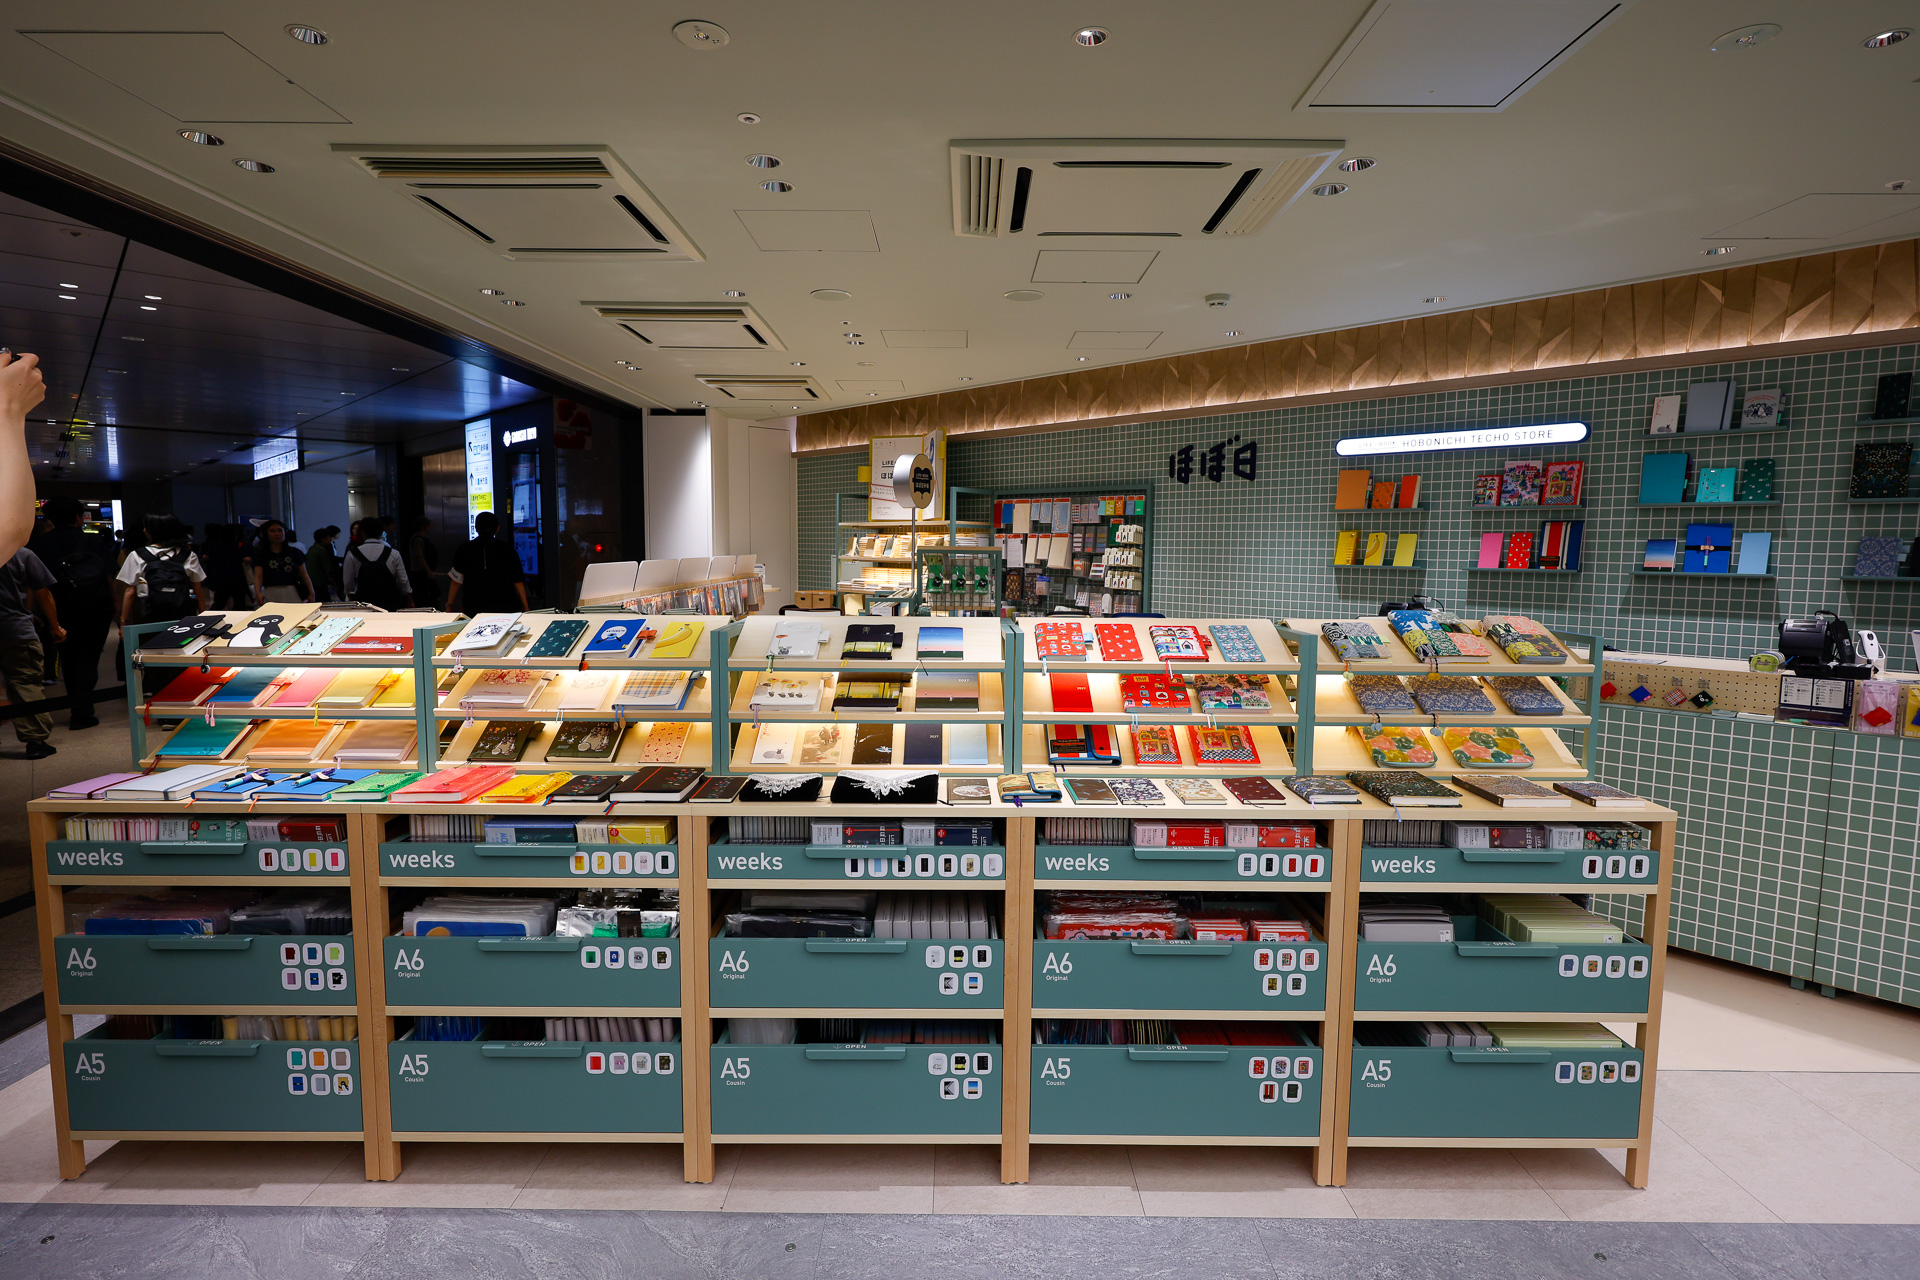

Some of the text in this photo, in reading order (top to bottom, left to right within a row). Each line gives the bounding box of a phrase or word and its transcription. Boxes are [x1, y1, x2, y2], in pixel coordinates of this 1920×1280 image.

[1402, 436, 1466, 447] HOBONICHI
[1471, 433, 1510, 443] TECHO
[1514, 430, 1554, 441] STORE
[1169, 434, 1257, 484] ほぼ日
[57, 848, 124, 866] weeks
[389, 849, 455, 868] weeks
[718, 851, 783, 871] weeks
[1044, 853, 1110, 872] weeks
[1371, 855, 1436, 874] weeks
[66, 948, 97, 969] A6
[394, 948, 425, 970] A6
[718, 951, 749, 973] A6
[1042, 952, 1073, 974] A6
[1366, 953, 1397, 976] A6
[398, 971, 421, 979] Original
[722, 973, 745, 981] Original
[1369, 976, 1392, 984] Original
[75, 1053, 106, 1074] A5
[398, 1054, 429, 1076] A5
[720, 1057, 751, 1079] A5
[1040, 1058, 1071, 1080] A5
[1361, 1060, 1392, 1082] A5
